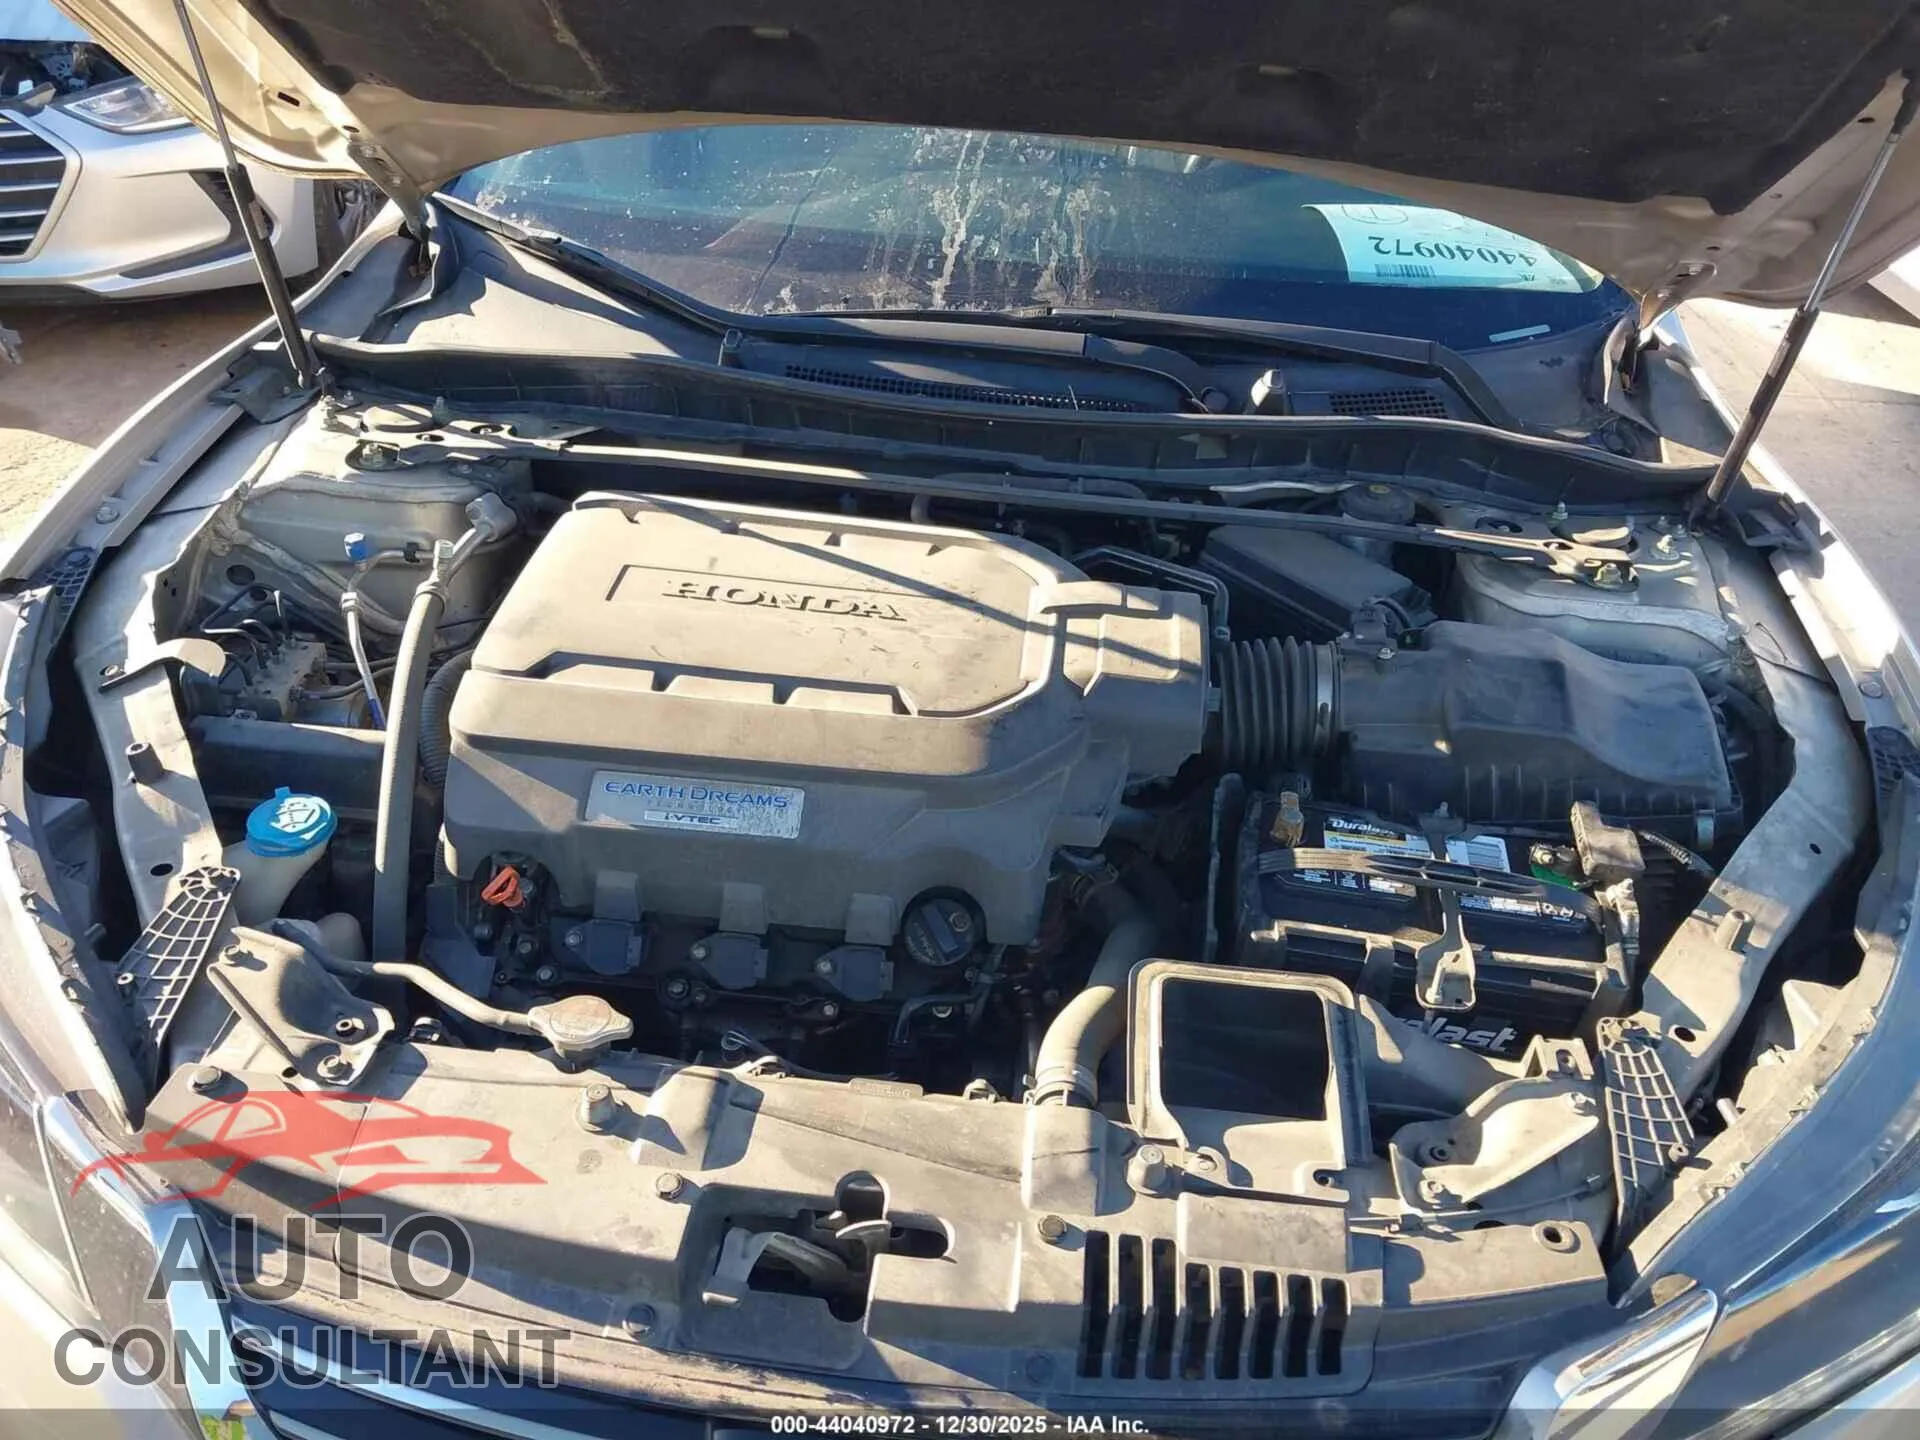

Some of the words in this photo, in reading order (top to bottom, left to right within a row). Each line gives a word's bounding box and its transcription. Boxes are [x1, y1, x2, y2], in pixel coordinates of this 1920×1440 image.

[1368, 235, 1538, 267] 44040972
[662, 580, 907, 622] HONDA
[605, 781, 684, 801] EARTH
[690, 786, 789, 808] DREAMS
